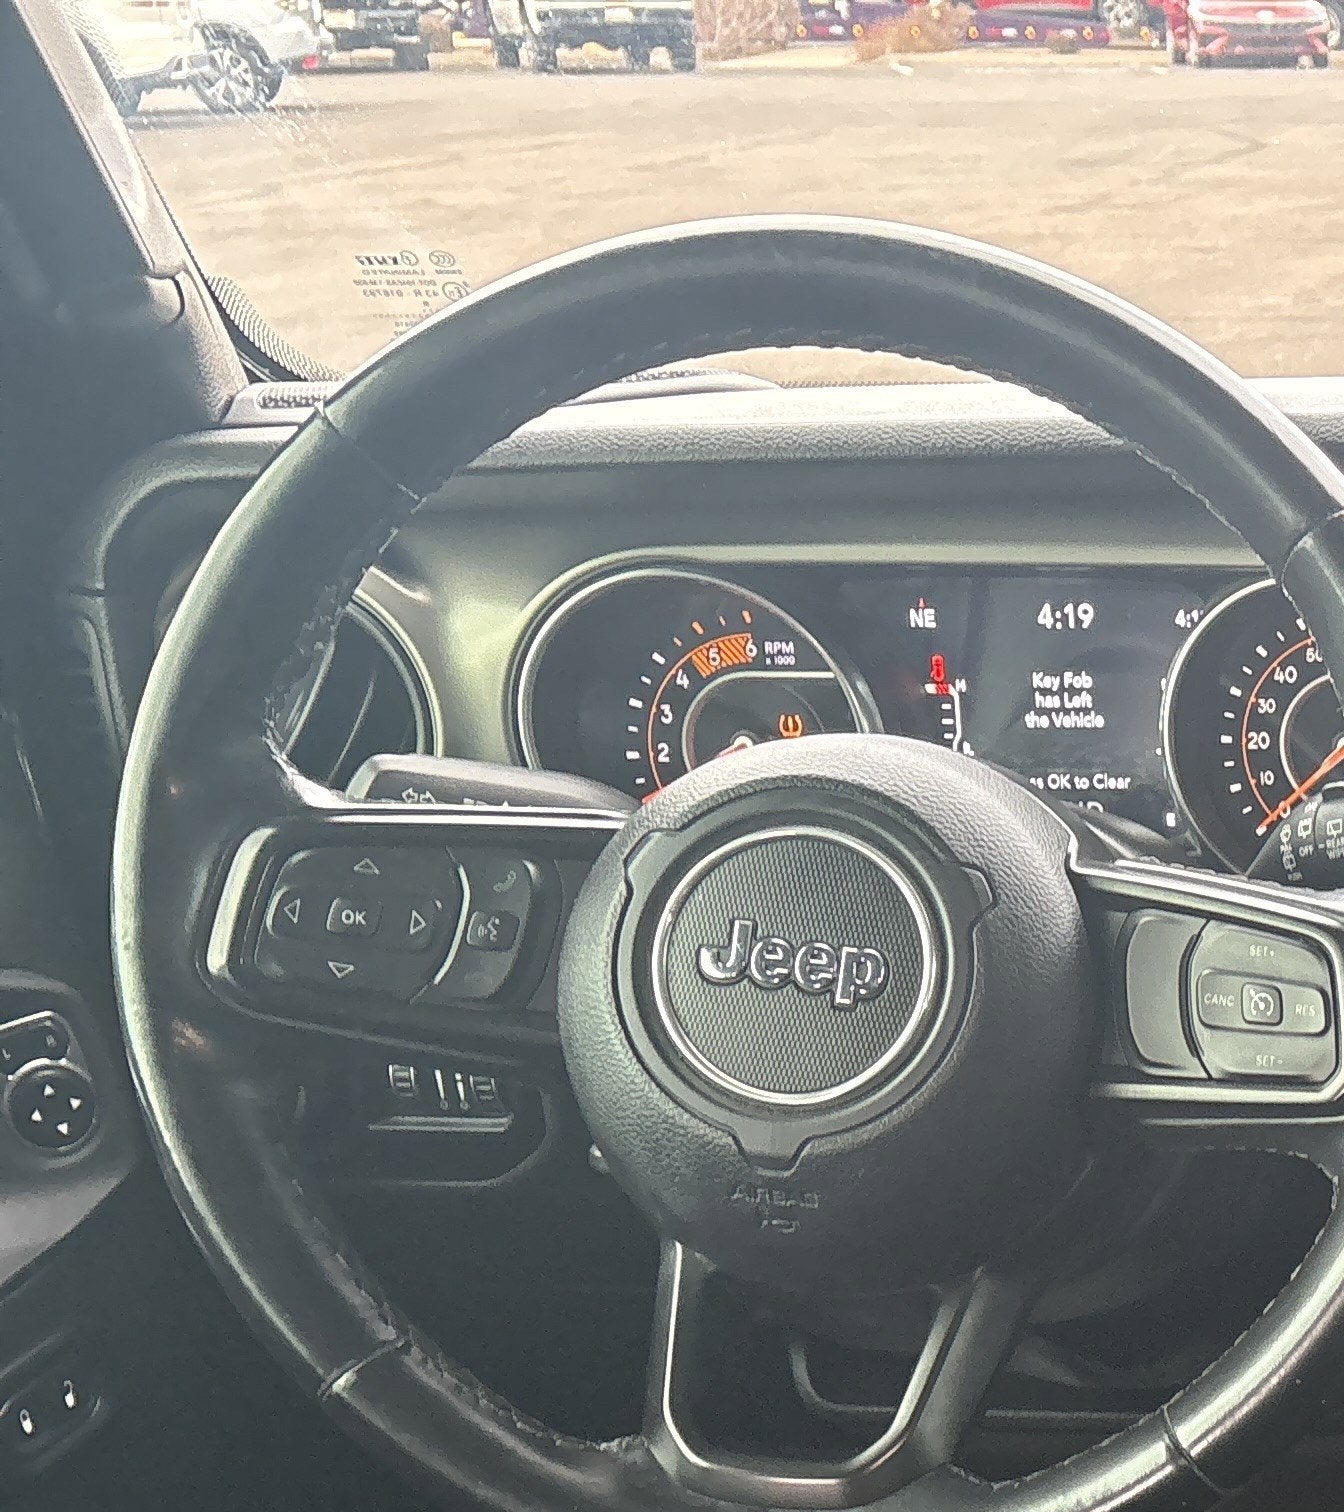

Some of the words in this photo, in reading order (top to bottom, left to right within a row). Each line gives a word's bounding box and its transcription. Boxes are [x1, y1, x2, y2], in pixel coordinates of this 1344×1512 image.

[909, 607, 937, 629] NE
[1036, 602, 1095, 630] 4:19
[1174, 608, 1204, 628] 4:1
[708, 647, 721, 666] 5
[745, 637, 758, 658] 6
[764, 641, 796, 655] RPM
[773, 655, 796, 666] 1000
[675, 668, 690, 690] 4
[1031, 671, 1060, 692] Key
[1063, 670, 1093, 690] Fob
[1273, 665, 1298, 684] 40
[1034, 691, 1060, 709] has
[1063, 691, 1093, 709] Left
[1257, 698, 1277, 714] 30
[660, 703, 673, 725] 3
[1024, 711, 1050, 729] the
[1051, 710, 1106, 729] Vehicle
[1247, 731, 1271, 750] 20
[657, 742, 671, 763] 2
[1048, 773, 1072, 790] OK
[1074, 774, 1090, 790] to
[1092, 772, 1131, 790] Clear
[1259, 770, 1275, 786] 10
[340, 910, 368, 926] OK
[699, 918, 891, 1009] Jeep
[1203, 992, 1235, 1008] CANC
[1295, 1003, 1316, 1017] RES
